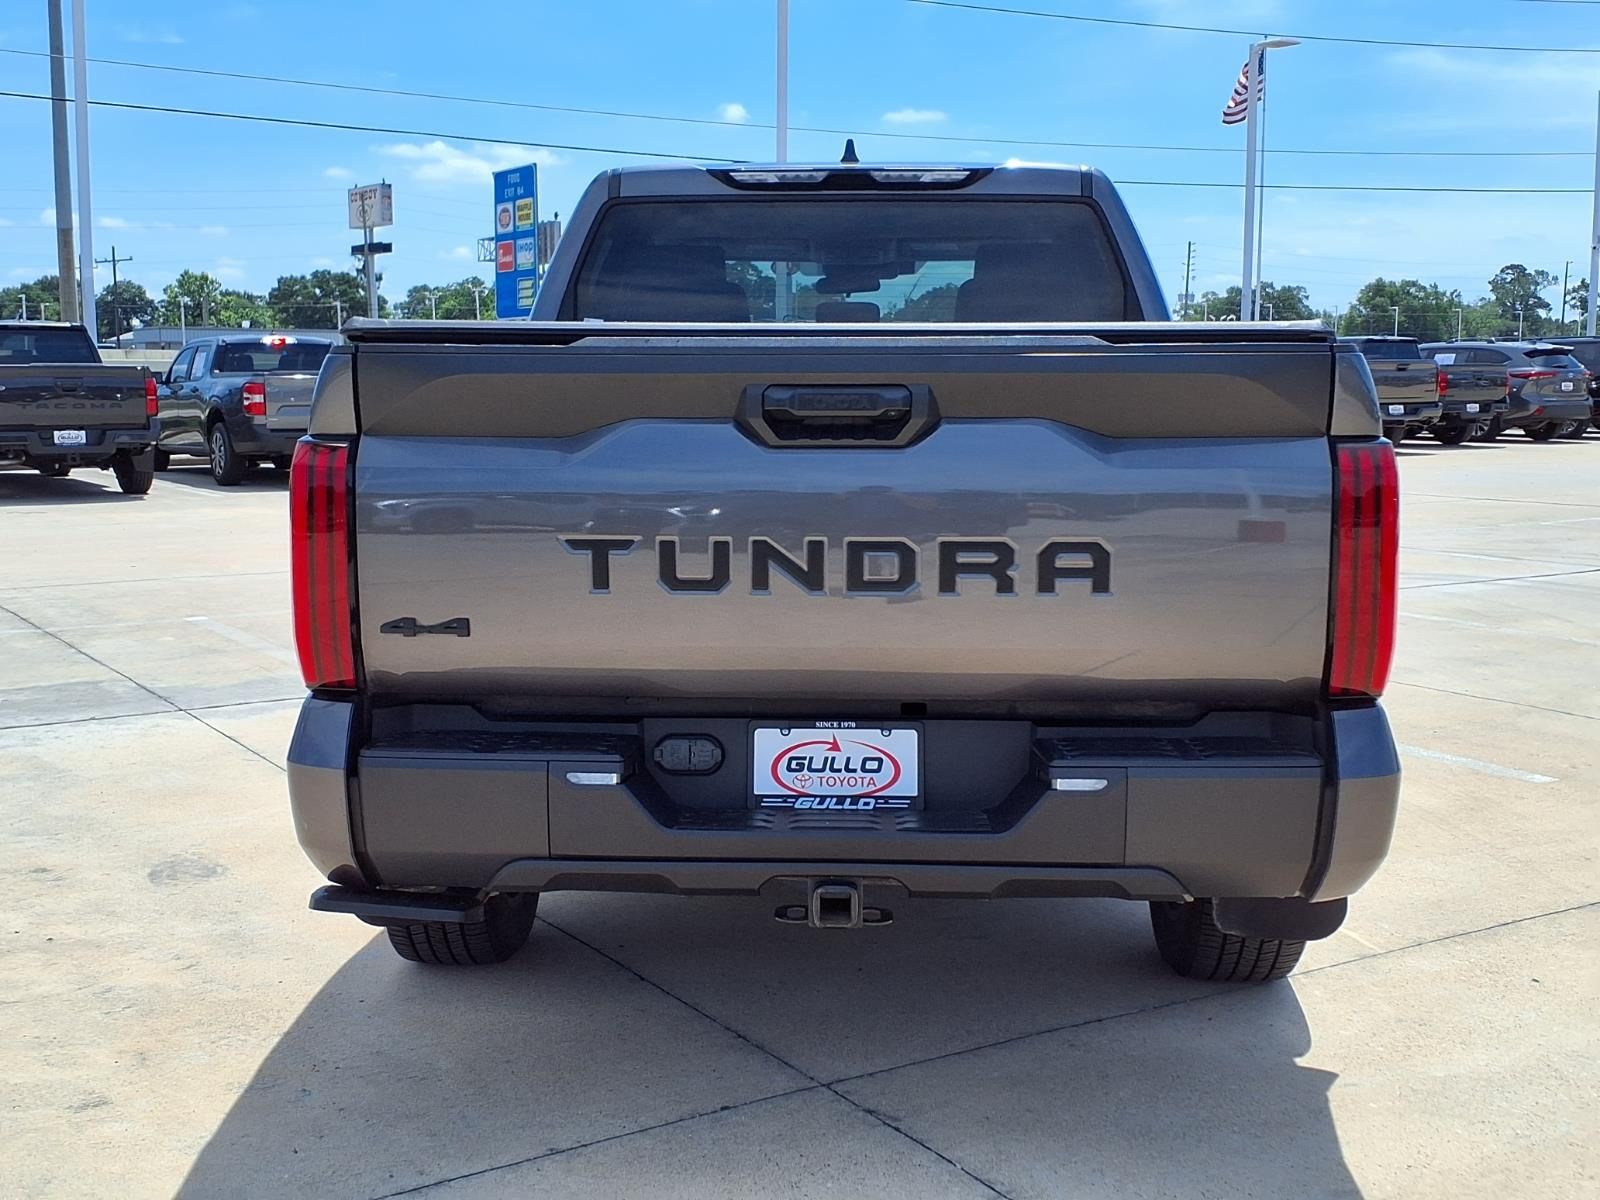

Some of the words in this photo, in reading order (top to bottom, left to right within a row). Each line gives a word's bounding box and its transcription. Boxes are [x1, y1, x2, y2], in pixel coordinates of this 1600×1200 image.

[507, 173, 521, 185] FOOD
[504, 187, 515, 199] EXIT
[555, 535, 1115, 597] TUNDRA
[785, 756, 884, 774] GULLO
[817, 776, 877, 788] TOYOTA
[794, 797, 876, 810] GULLO
